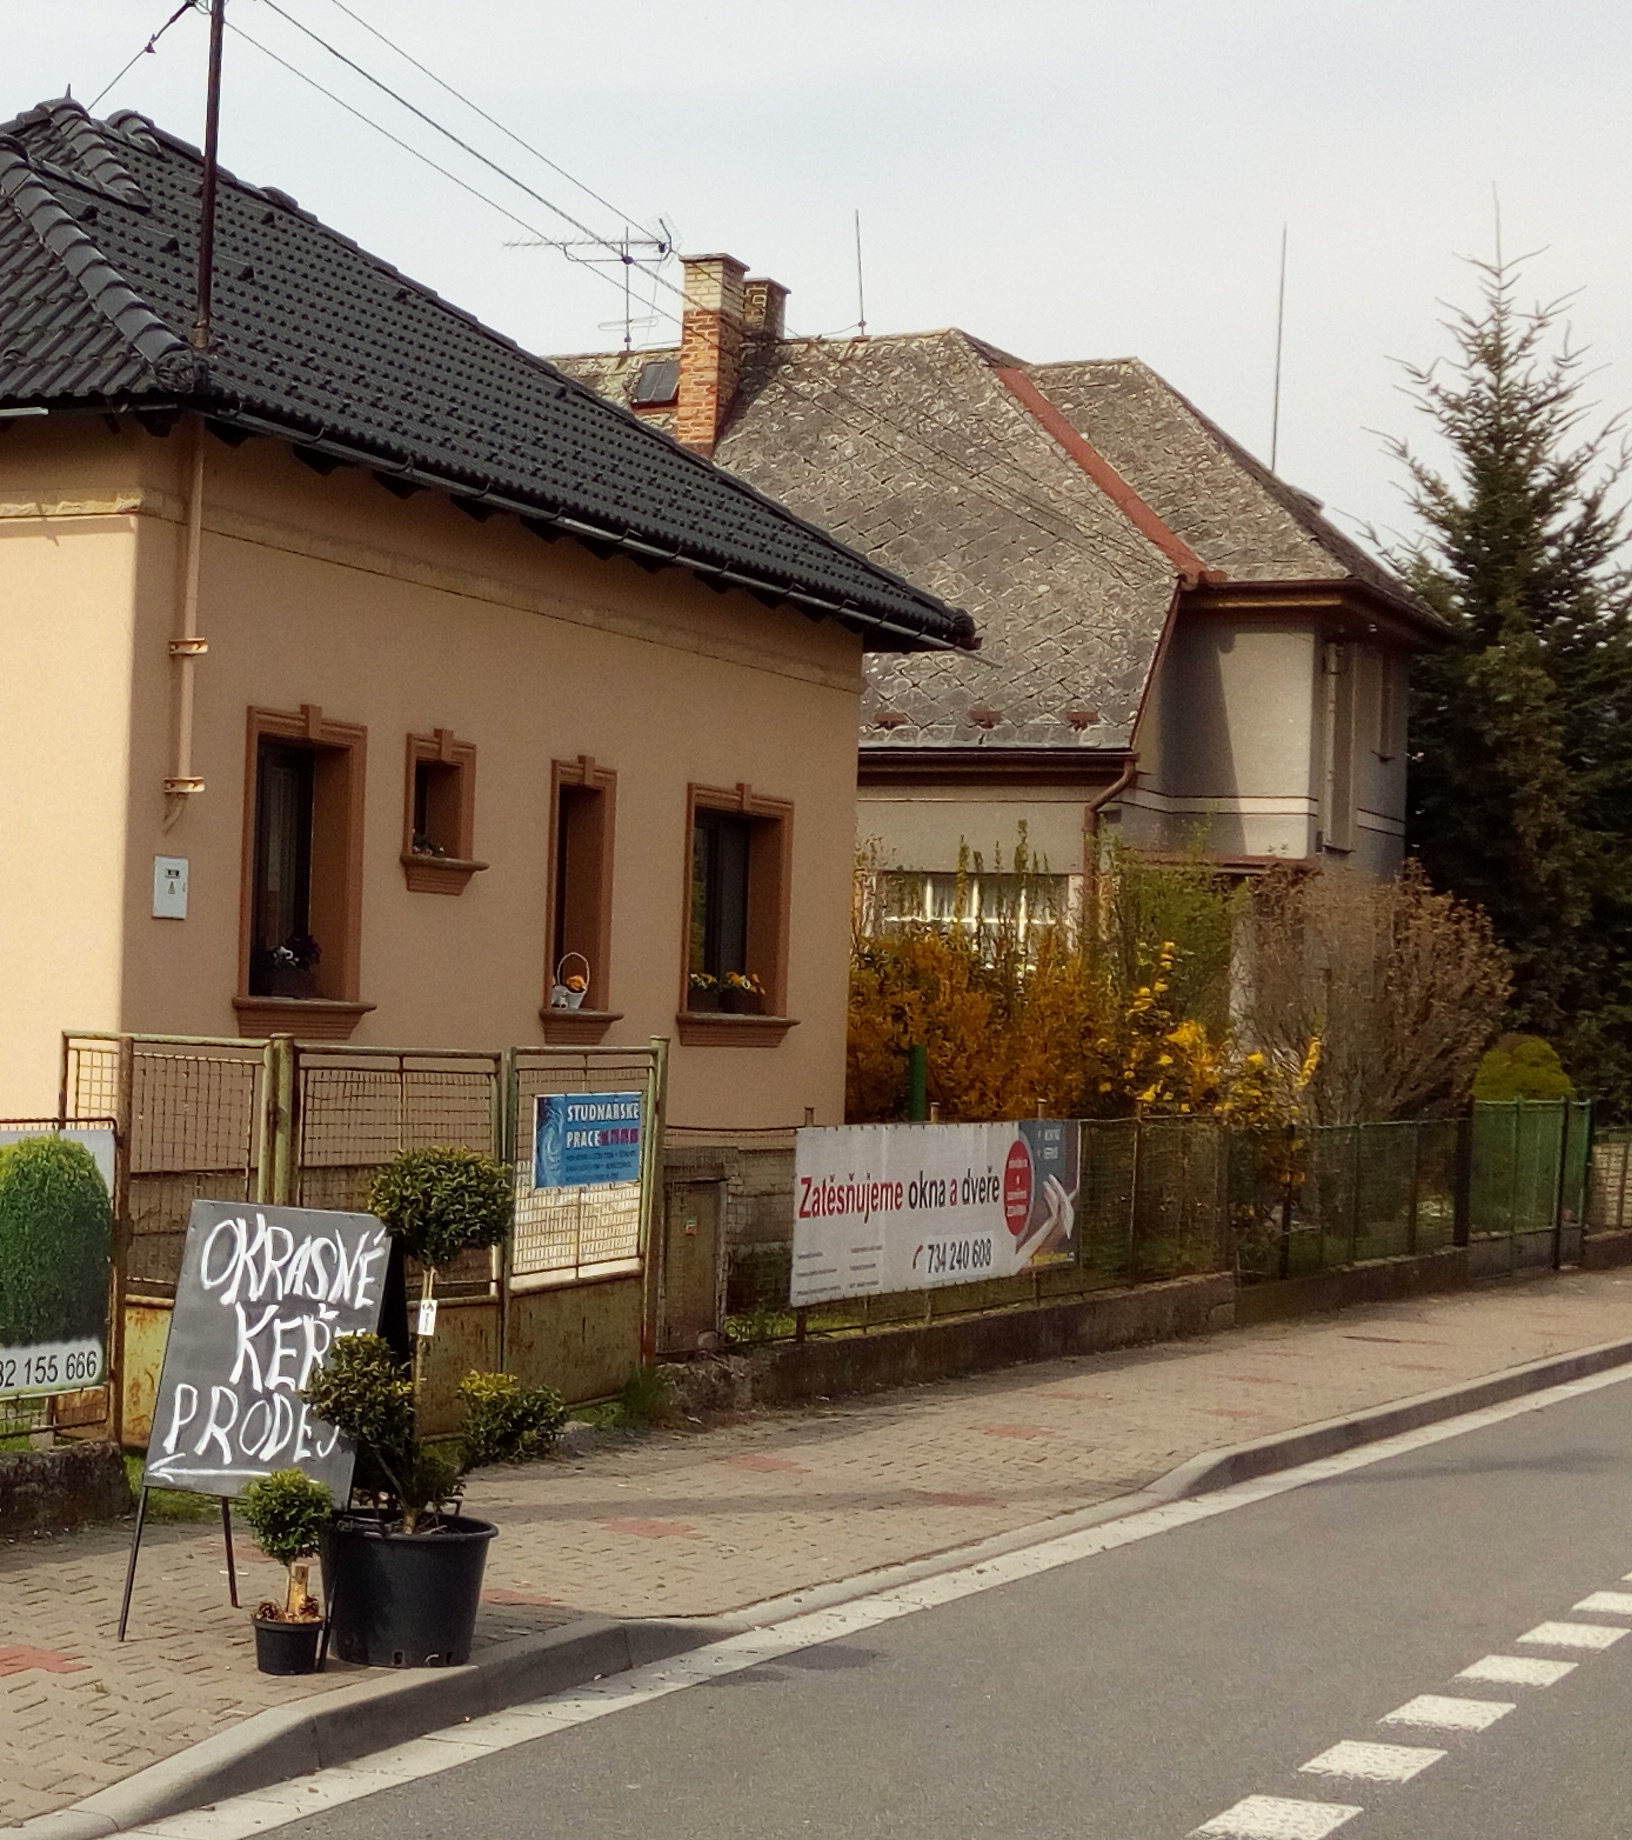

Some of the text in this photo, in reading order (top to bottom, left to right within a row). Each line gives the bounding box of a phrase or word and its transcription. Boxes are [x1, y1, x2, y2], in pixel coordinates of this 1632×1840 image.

[566, 1126, 601, 1148] PRÁCE
[799, 1166, 1000, 1224] Zatěsňujeme okna a dveře
[200, 1213, 387, 1309] OKRASNÉ
[927, 1238, 992, 1273] 734 240 608
[24, 1355, 58, 1385] 155
[66, 1350, 97, 1380] 666
[229, 1301, 367, 1393] KEŘ
